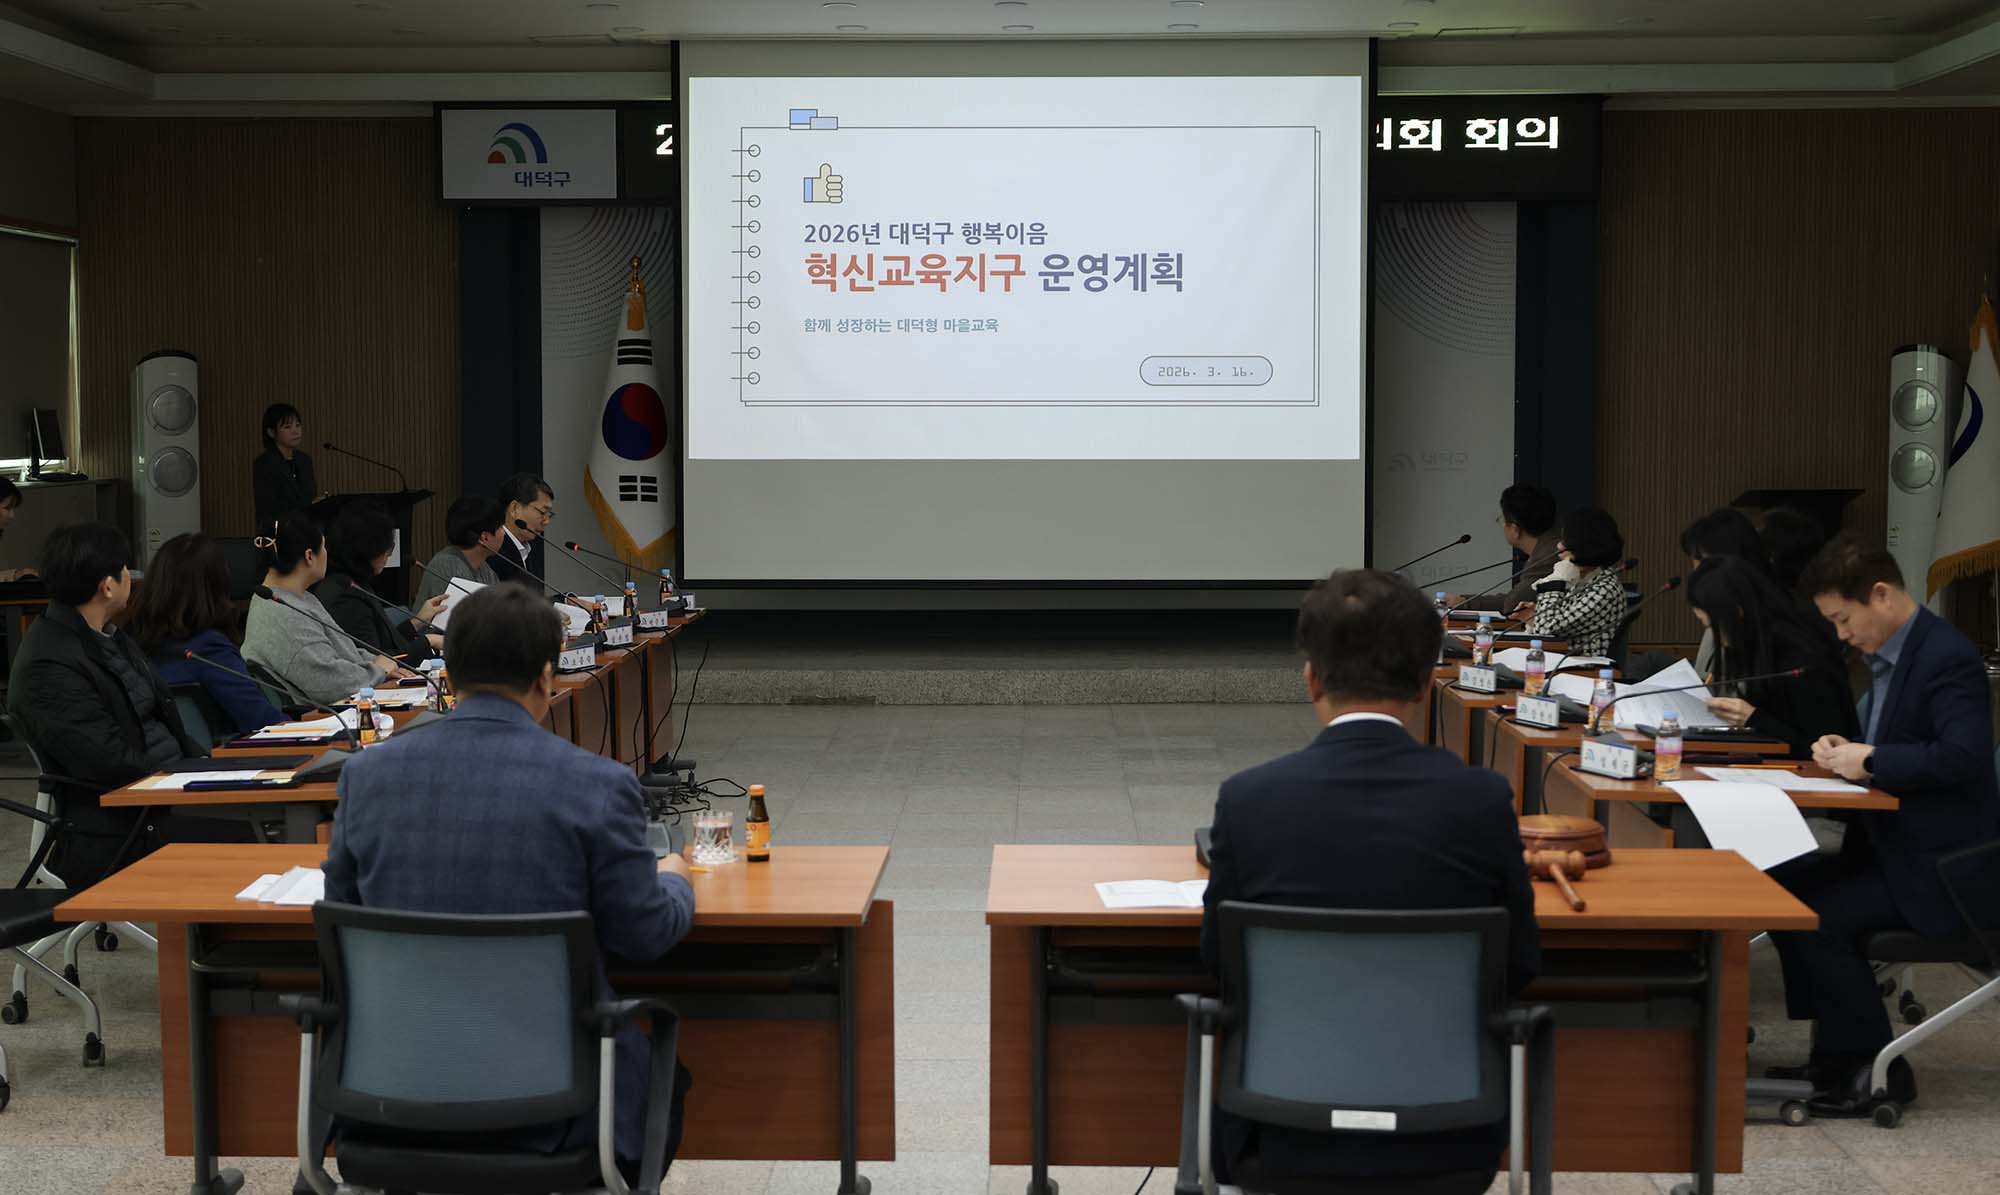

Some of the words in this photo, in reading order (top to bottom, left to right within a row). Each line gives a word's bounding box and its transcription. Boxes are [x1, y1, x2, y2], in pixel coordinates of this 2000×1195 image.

[1464, 116, 1559, 151] 회의
[514, 171, 571, 188] 대덕구
[804, 222, 881, 246] 2026년
[888, 222, 955, 246] 대덕구
[961, 222, 1048, 246] 행복이음
[804, 252, 1027, 293] 혁신교육지구
[1037, 252, 1184, 293] 운영계획
[803, 318, 832, 334] 함께
[836, 318, 893, 334] 성장하는
[897, 318, 938, 333] 대덕형
[943, 318, 1000, 333] 마을교육
[1158, 366, 1198, 377] 2026.
[1207, 366, 1221, 377] 3.
[1231, 366, 1254, 377] 16.
